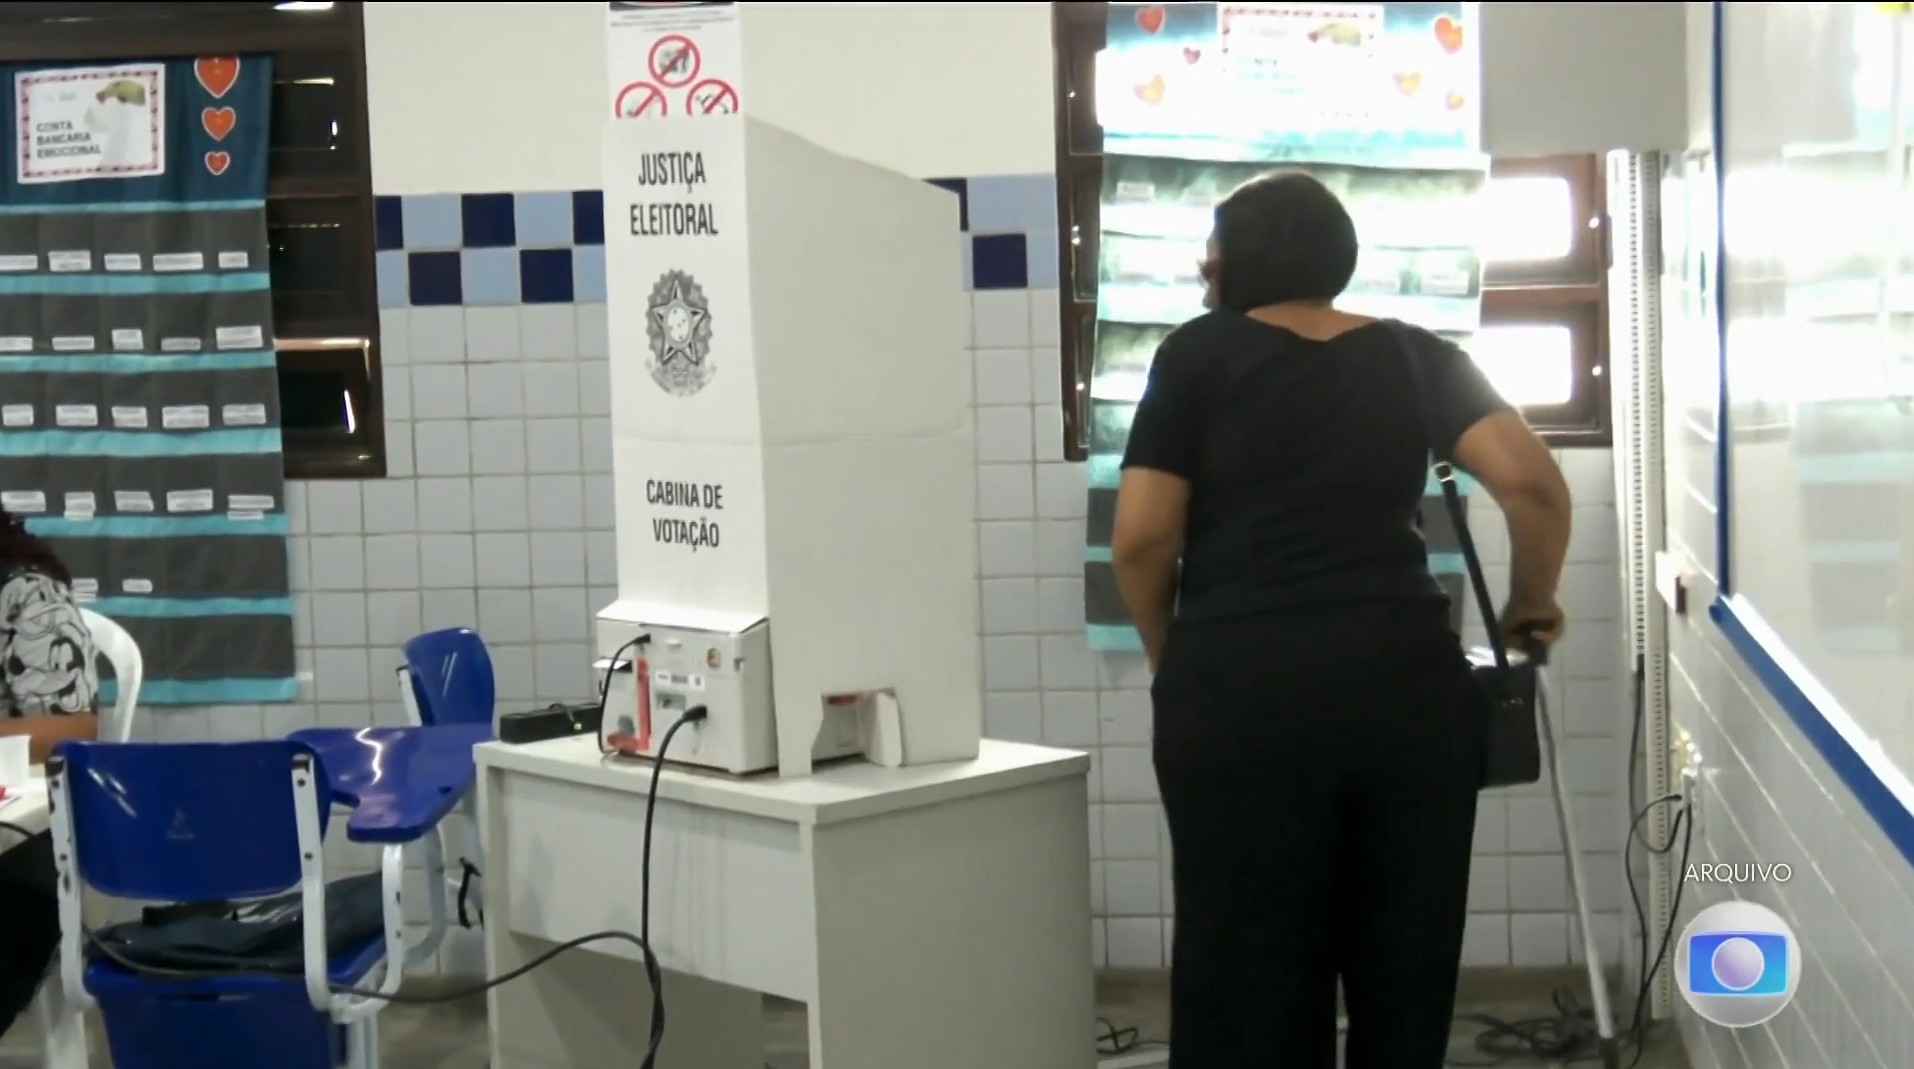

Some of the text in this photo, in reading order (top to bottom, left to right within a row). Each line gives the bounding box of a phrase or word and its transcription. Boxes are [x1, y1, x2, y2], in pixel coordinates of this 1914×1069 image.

[638, 152, 706, 193] JUSTIÇA
[630, 203, 719, 236] ELEITORAL
[646, 479, 724, 510] CABINA DE
[652, 516, 719, 553] VOTAÇÃO
